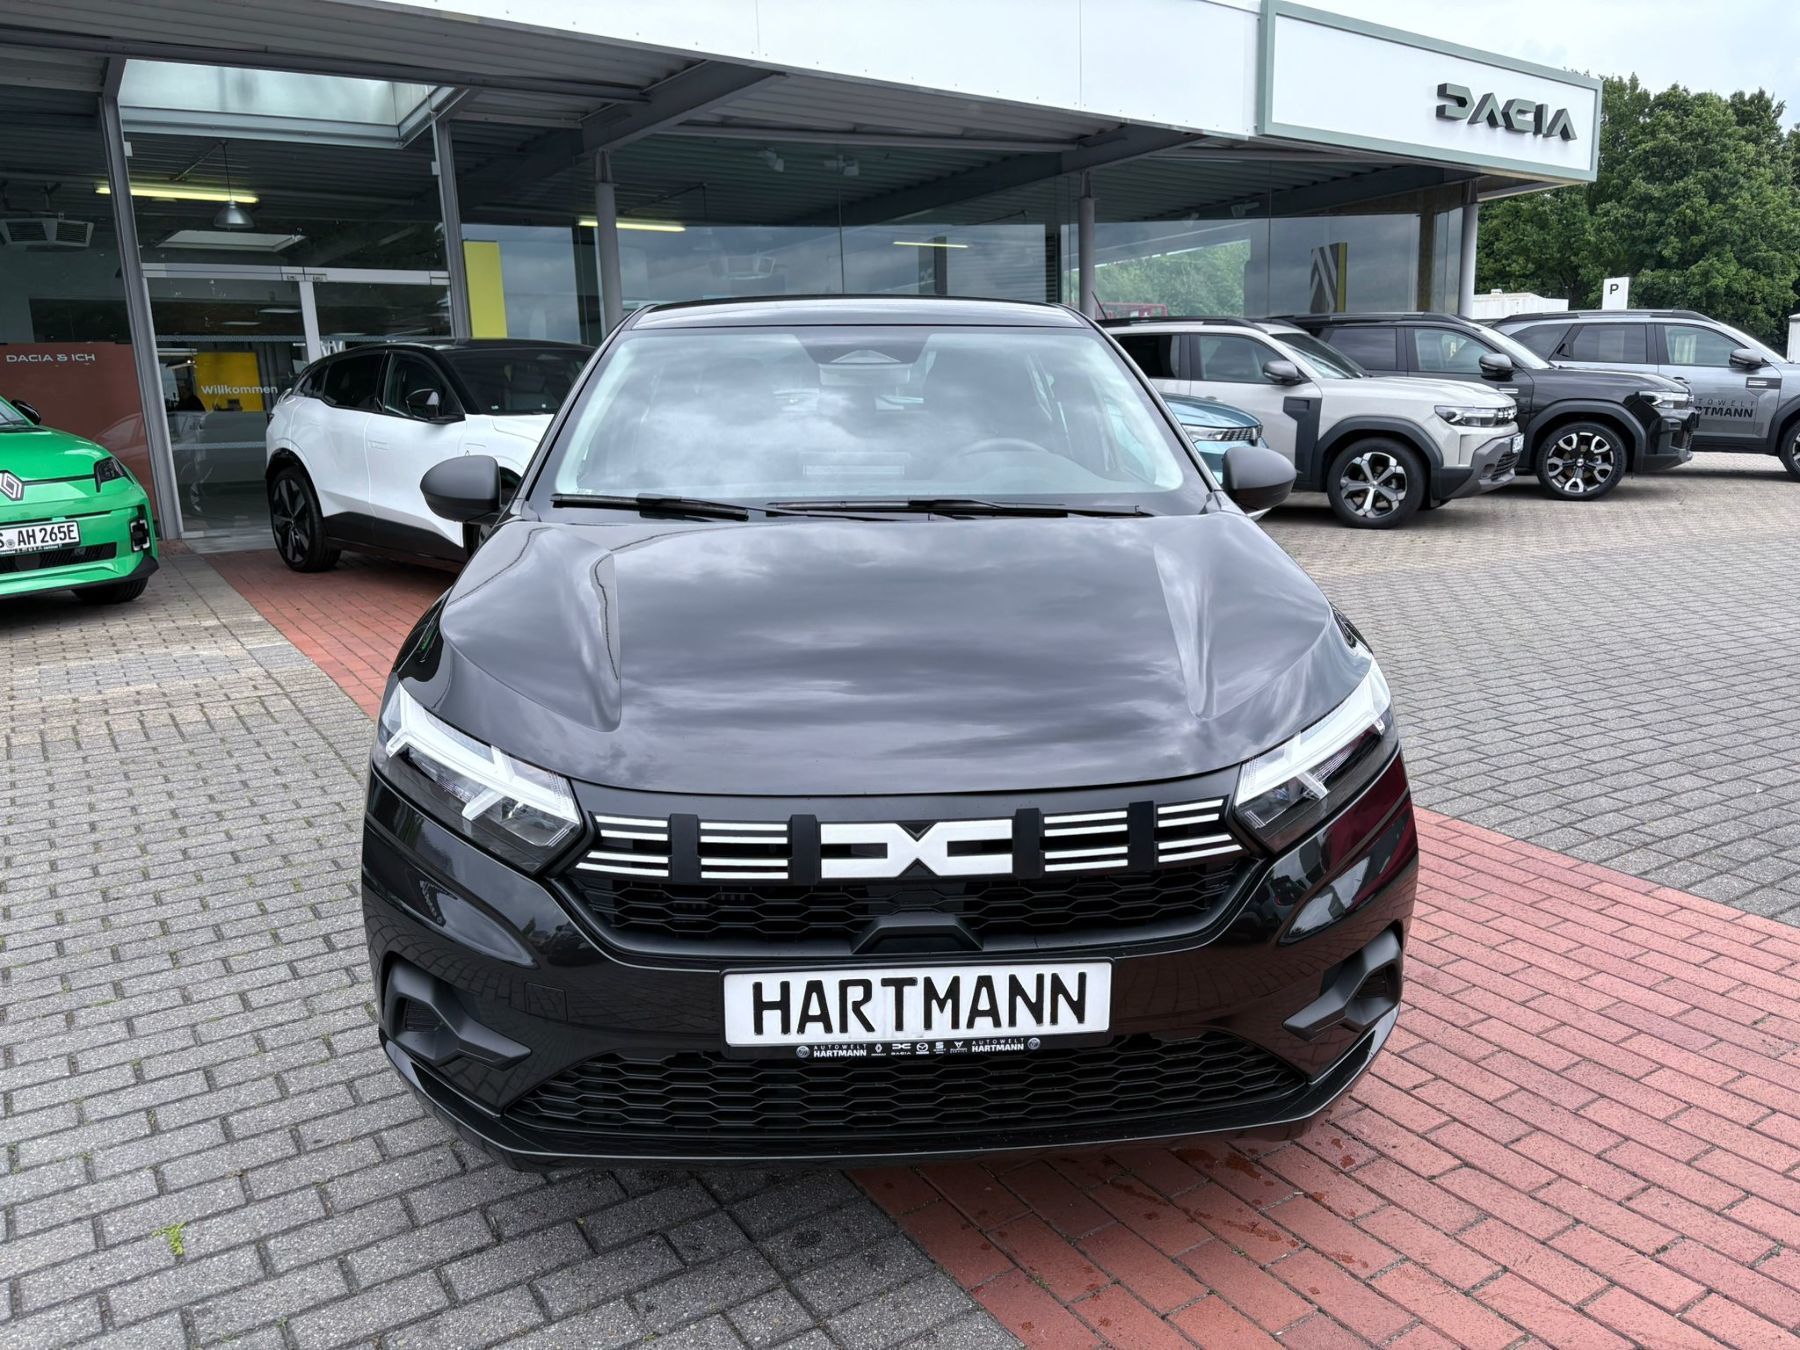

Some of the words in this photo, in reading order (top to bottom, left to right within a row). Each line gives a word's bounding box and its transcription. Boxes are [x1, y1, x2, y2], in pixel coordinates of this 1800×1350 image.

[1435, 82, 1577, 141] DACIA
[1609, 283, 1619, 294] P
[6, 354, 53, 362] DACIA
[71, 353, 96, 361] ICH
[200, 385, 278, 395] Willkommen
[17, 529, 37, 546] AH
[39, 524, 77, 544] 265E
[752, 971, 1088, 1036] HARTMANN
[972, 1037, 1024, 1045] AUTOWELT
[971, 1043, 1025, 1053] HARTMANN
[813, 1049, 867, 1058] HARTMANN
